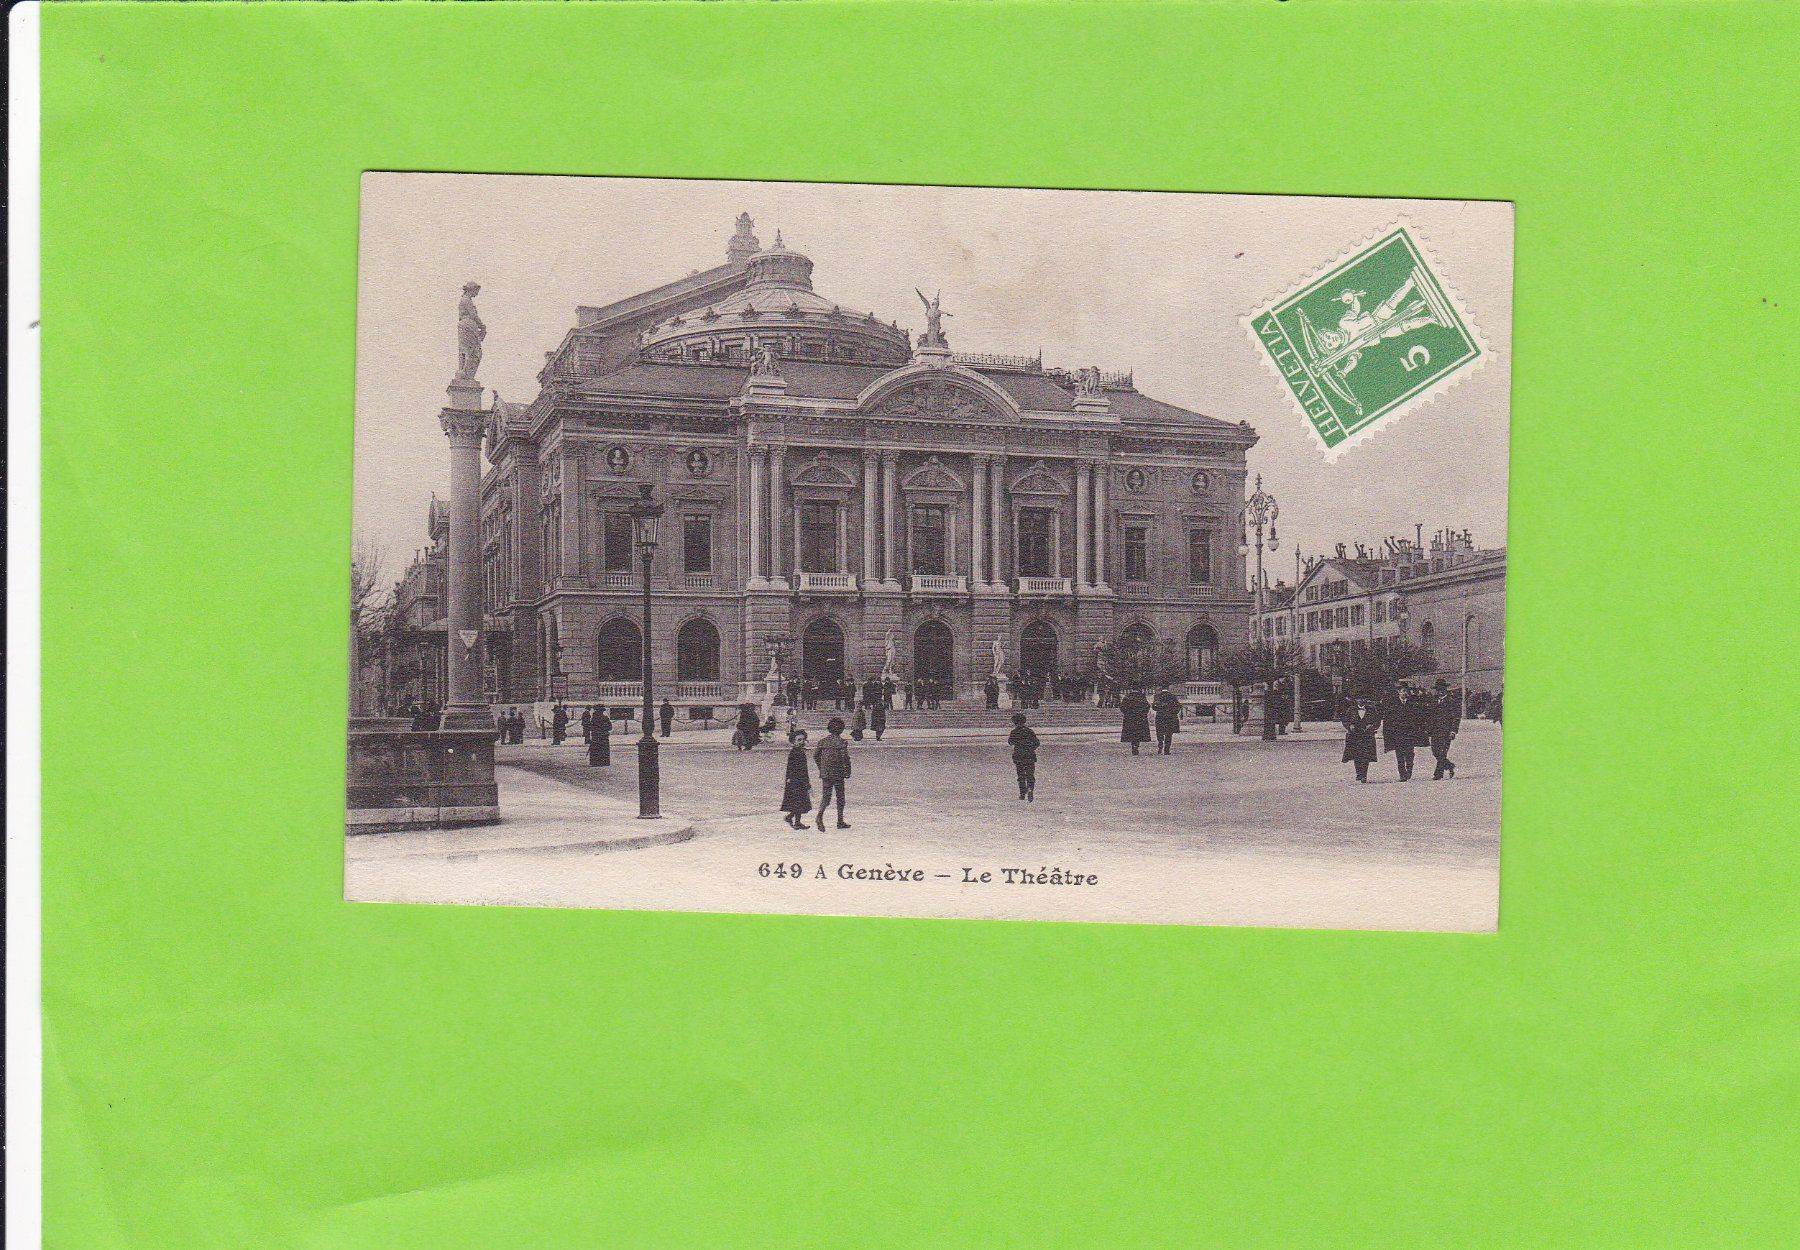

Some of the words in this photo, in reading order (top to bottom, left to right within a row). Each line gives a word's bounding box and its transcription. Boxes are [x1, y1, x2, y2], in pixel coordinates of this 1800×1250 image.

[1400, 344, 1430, 372] 5
[1260, 318, 1340, 438] HELVETIA
[758, 862, 803, 879] 649
[814, 864, 827, 880] A
[837, 863, 925, 882] Genève
[961, 867, 992, 884] Le
[1000, 866, 1099, 886] Théâtre
